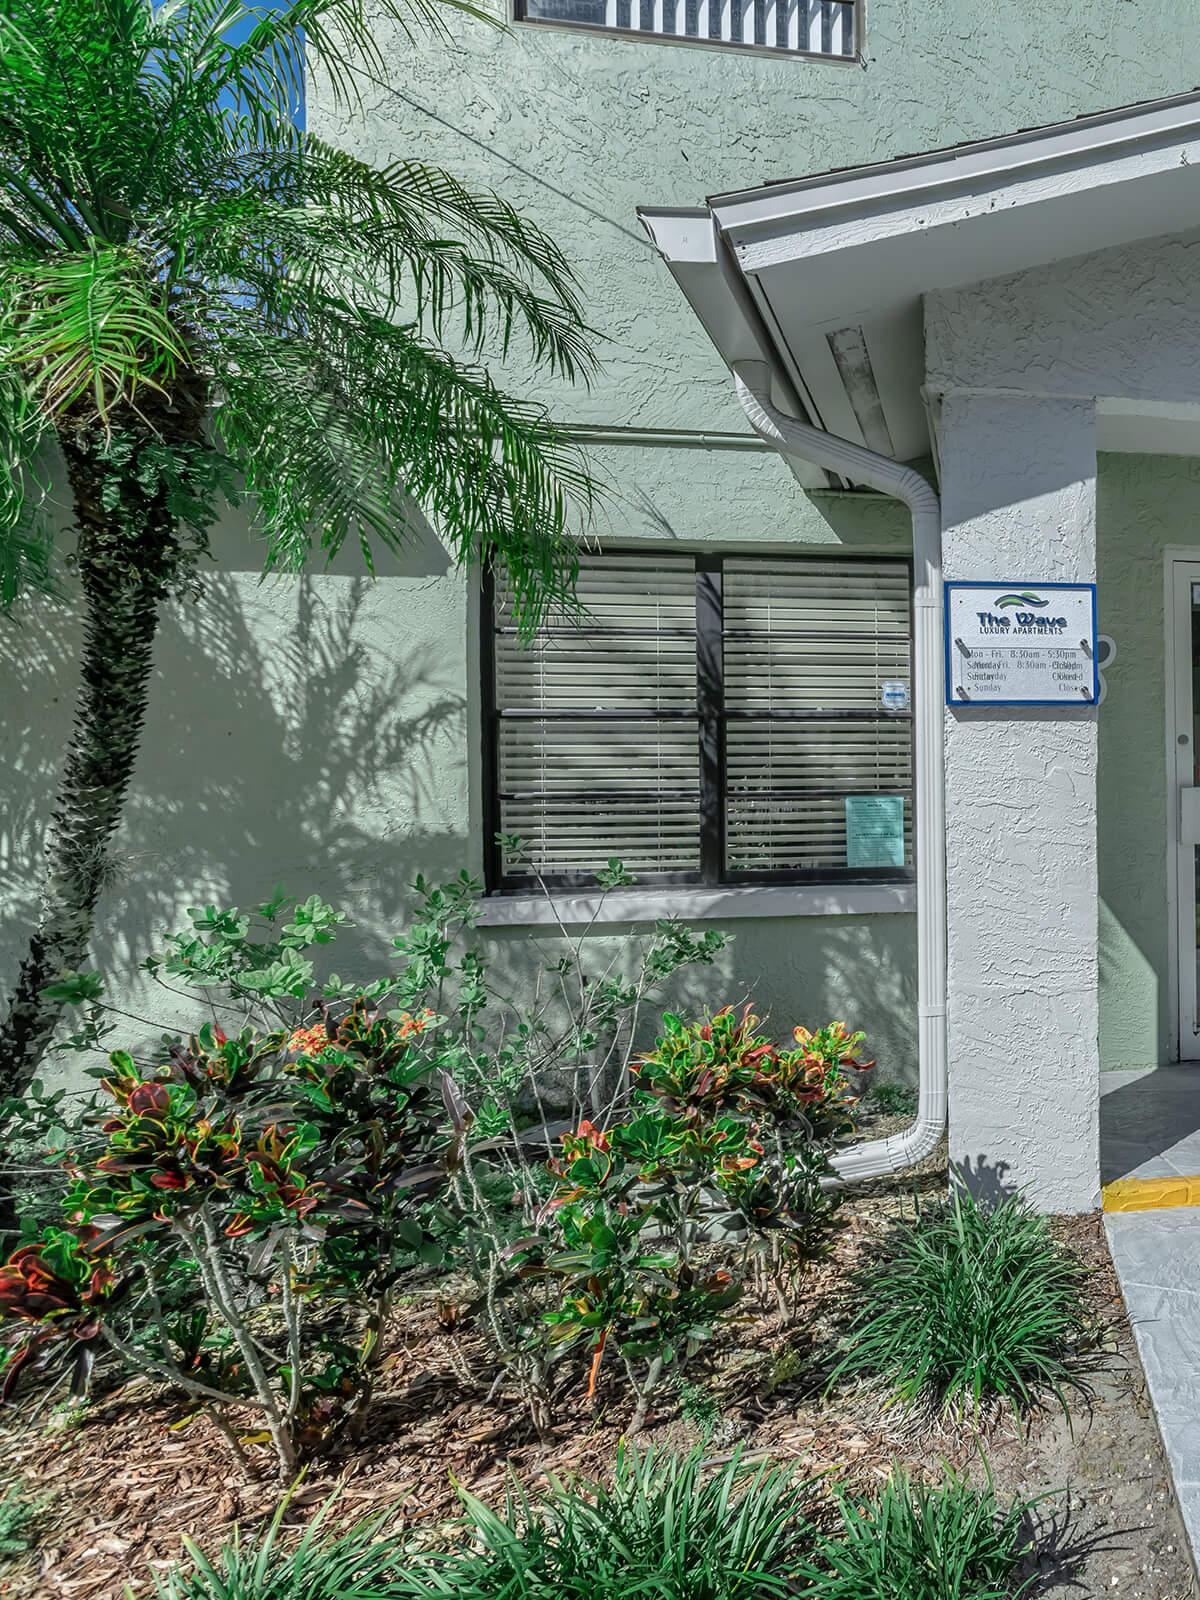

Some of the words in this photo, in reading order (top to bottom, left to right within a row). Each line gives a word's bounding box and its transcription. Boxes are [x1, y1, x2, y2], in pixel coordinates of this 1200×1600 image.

[976, 612, 1011, 627] The
[1016, 612, 1068, 627] Wave
[979, 627, 1010, 635] LUXURY
[1013, 627, 1063, 635] APARTMENTS
[1010, 650, 1040, 658] 8:30am
[1047, 650, 1077, 660] 5:30pm
